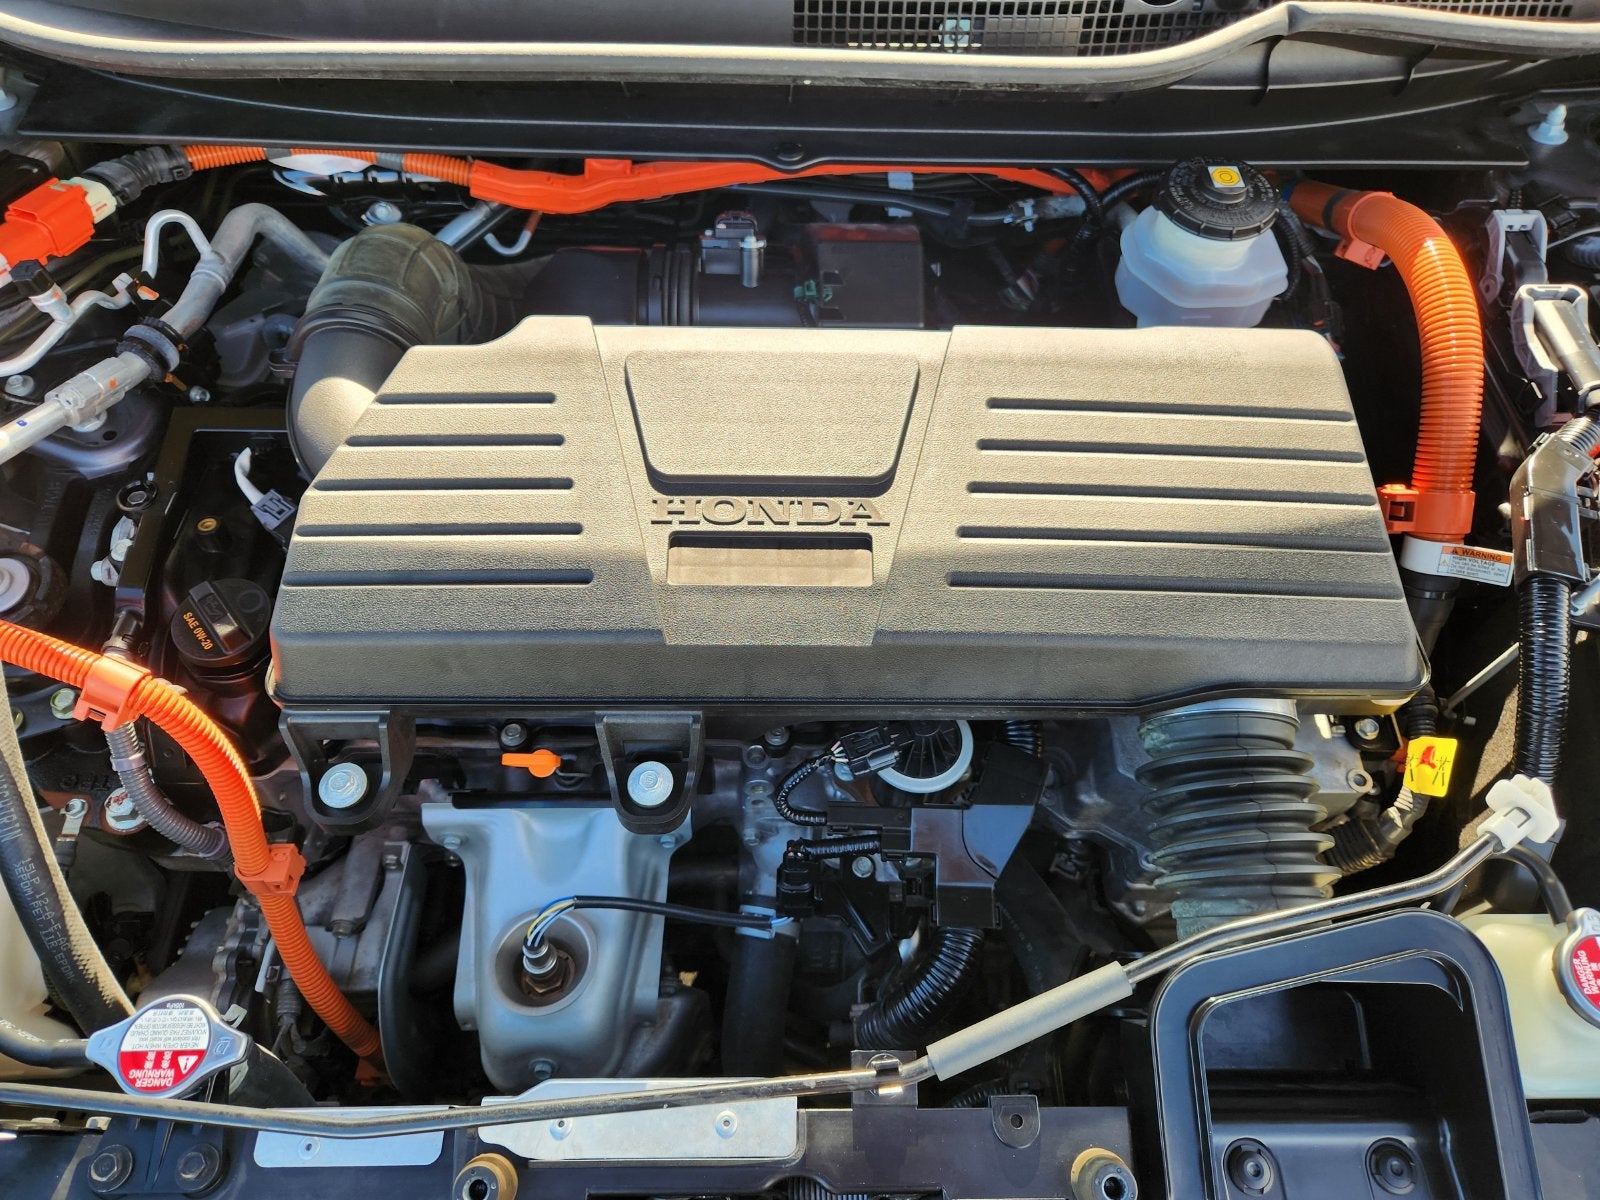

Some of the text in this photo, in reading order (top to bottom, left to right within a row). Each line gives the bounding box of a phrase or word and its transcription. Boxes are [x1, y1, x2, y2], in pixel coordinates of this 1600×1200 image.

[650, 498, 890, 527] HONDA
[1462, 548, 1502, 562] WARNING
[1468, 558, 1496, 566] VOLTAGE
[183, 612, 214, 650] SAE 0W-20
[0, 775, 24, 843] HIRIN
[22, 857, 71, 952] 15LP 12-A-E-AG
[1572, 958, 1593, 995] DANGER
[1578, 950, 1600, 995] WARNUNG
[128, 1068, 175, 1079] WARNUNG
[134, 1076, 173, 1088] DANGER
